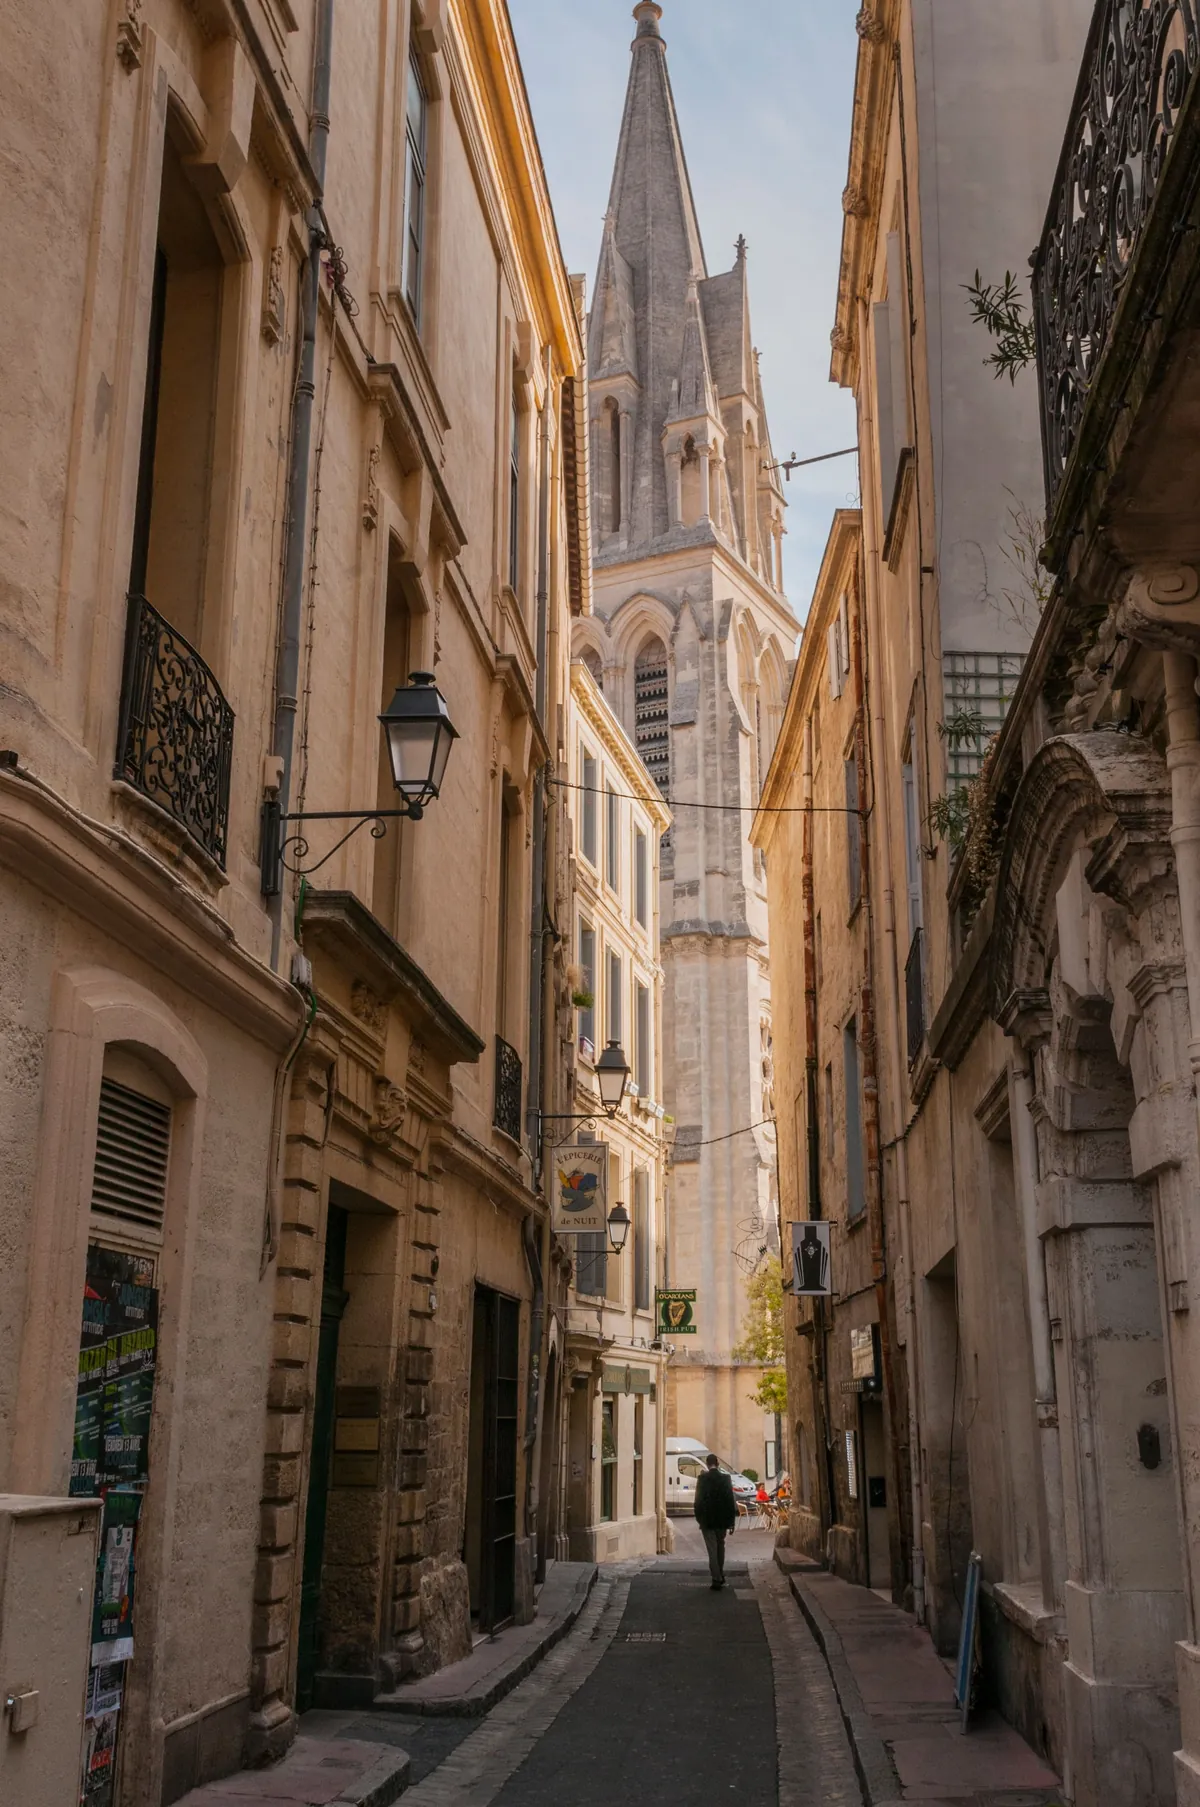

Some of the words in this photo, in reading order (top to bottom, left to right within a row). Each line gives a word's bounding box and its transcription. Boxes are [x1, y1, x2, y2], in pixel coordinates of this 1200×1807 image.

[557, 1151, 603, 1165] L'EPICERIE
[561, 1216, 571, 1225] de
[573, 1217, 598, 1225] NUIT
